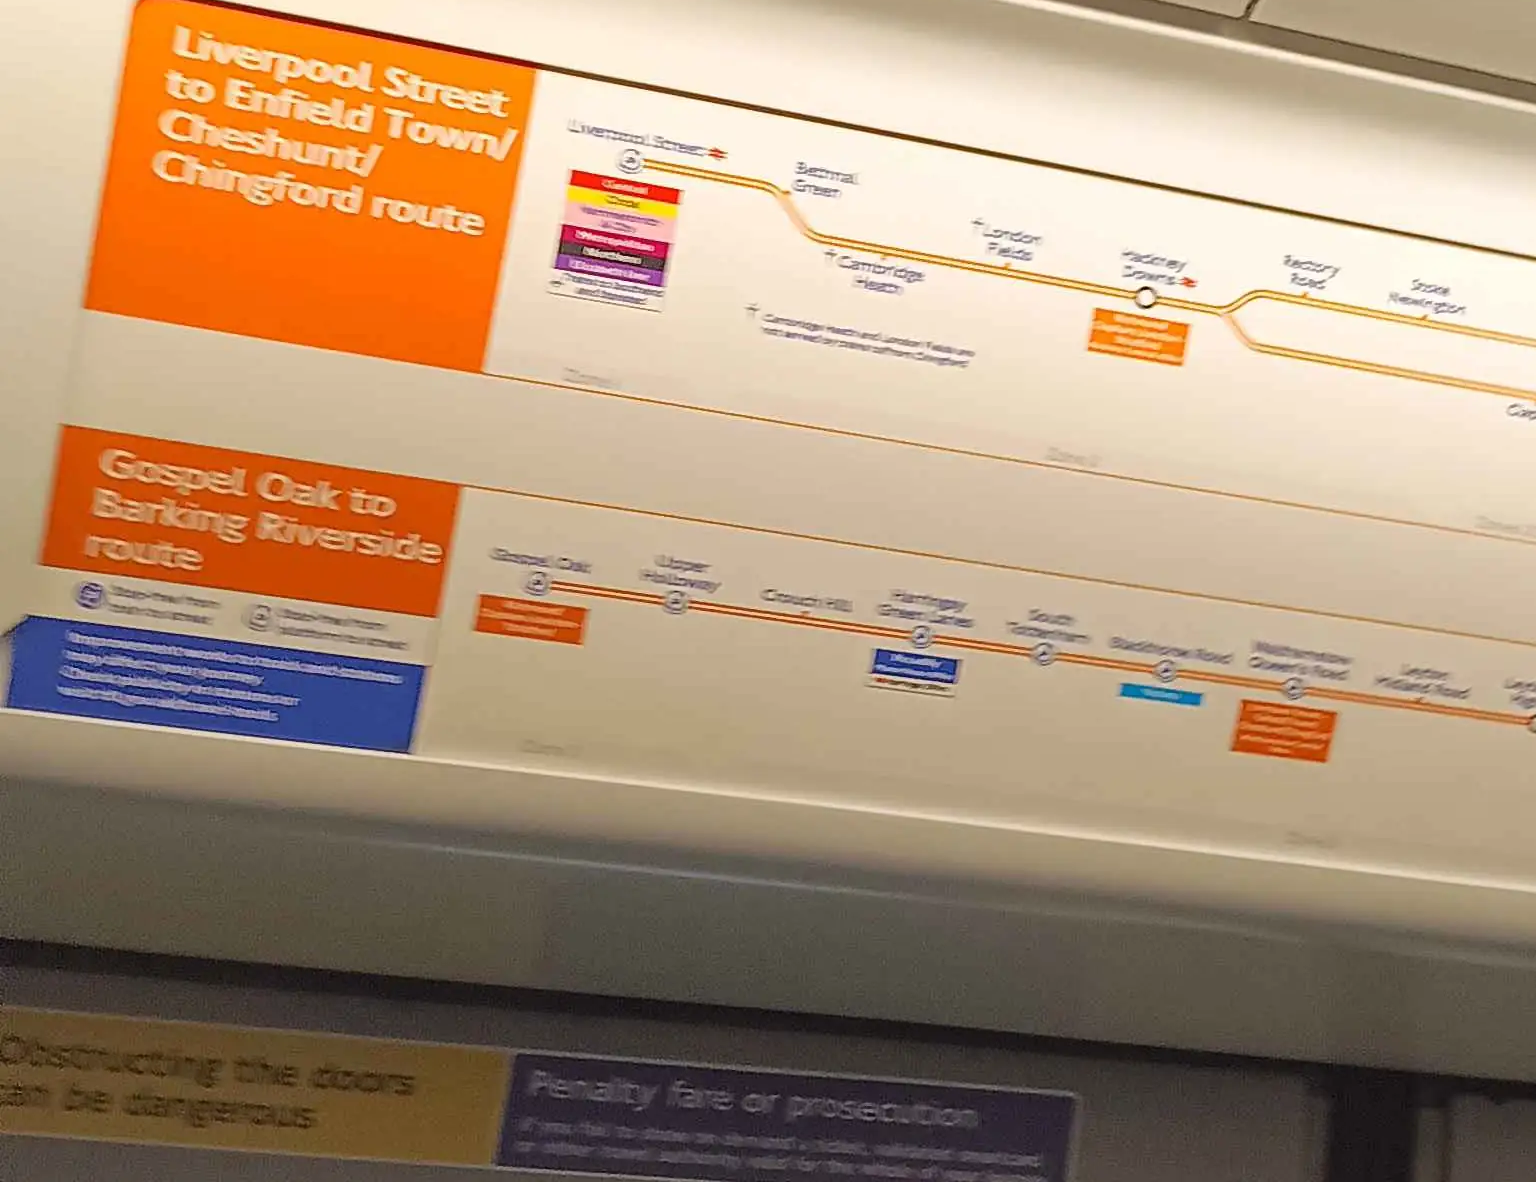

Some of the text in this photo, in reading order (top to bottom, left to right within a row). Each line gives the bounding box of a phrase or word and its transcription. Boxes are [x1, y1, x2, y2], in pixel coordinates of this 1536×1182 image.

[172, 25, 512, 118] Liverpool Street
[158, 109, 384, 178] Cheshunt/
[164, 69, 519, 162] to Enfield Town/
[152, 149, 486, 236] Chingford route
[98, 448, 397, 519] Gospel Oak to
[83, 533, 205, 572] route
[90, 486, 445, 565] Barking Riverside
[121, 1086, 318, 1130] dangerous
[310, 1058, 416, 1097] doors
[526, 1068, 980, 1129] Penalty fare or prosecution
